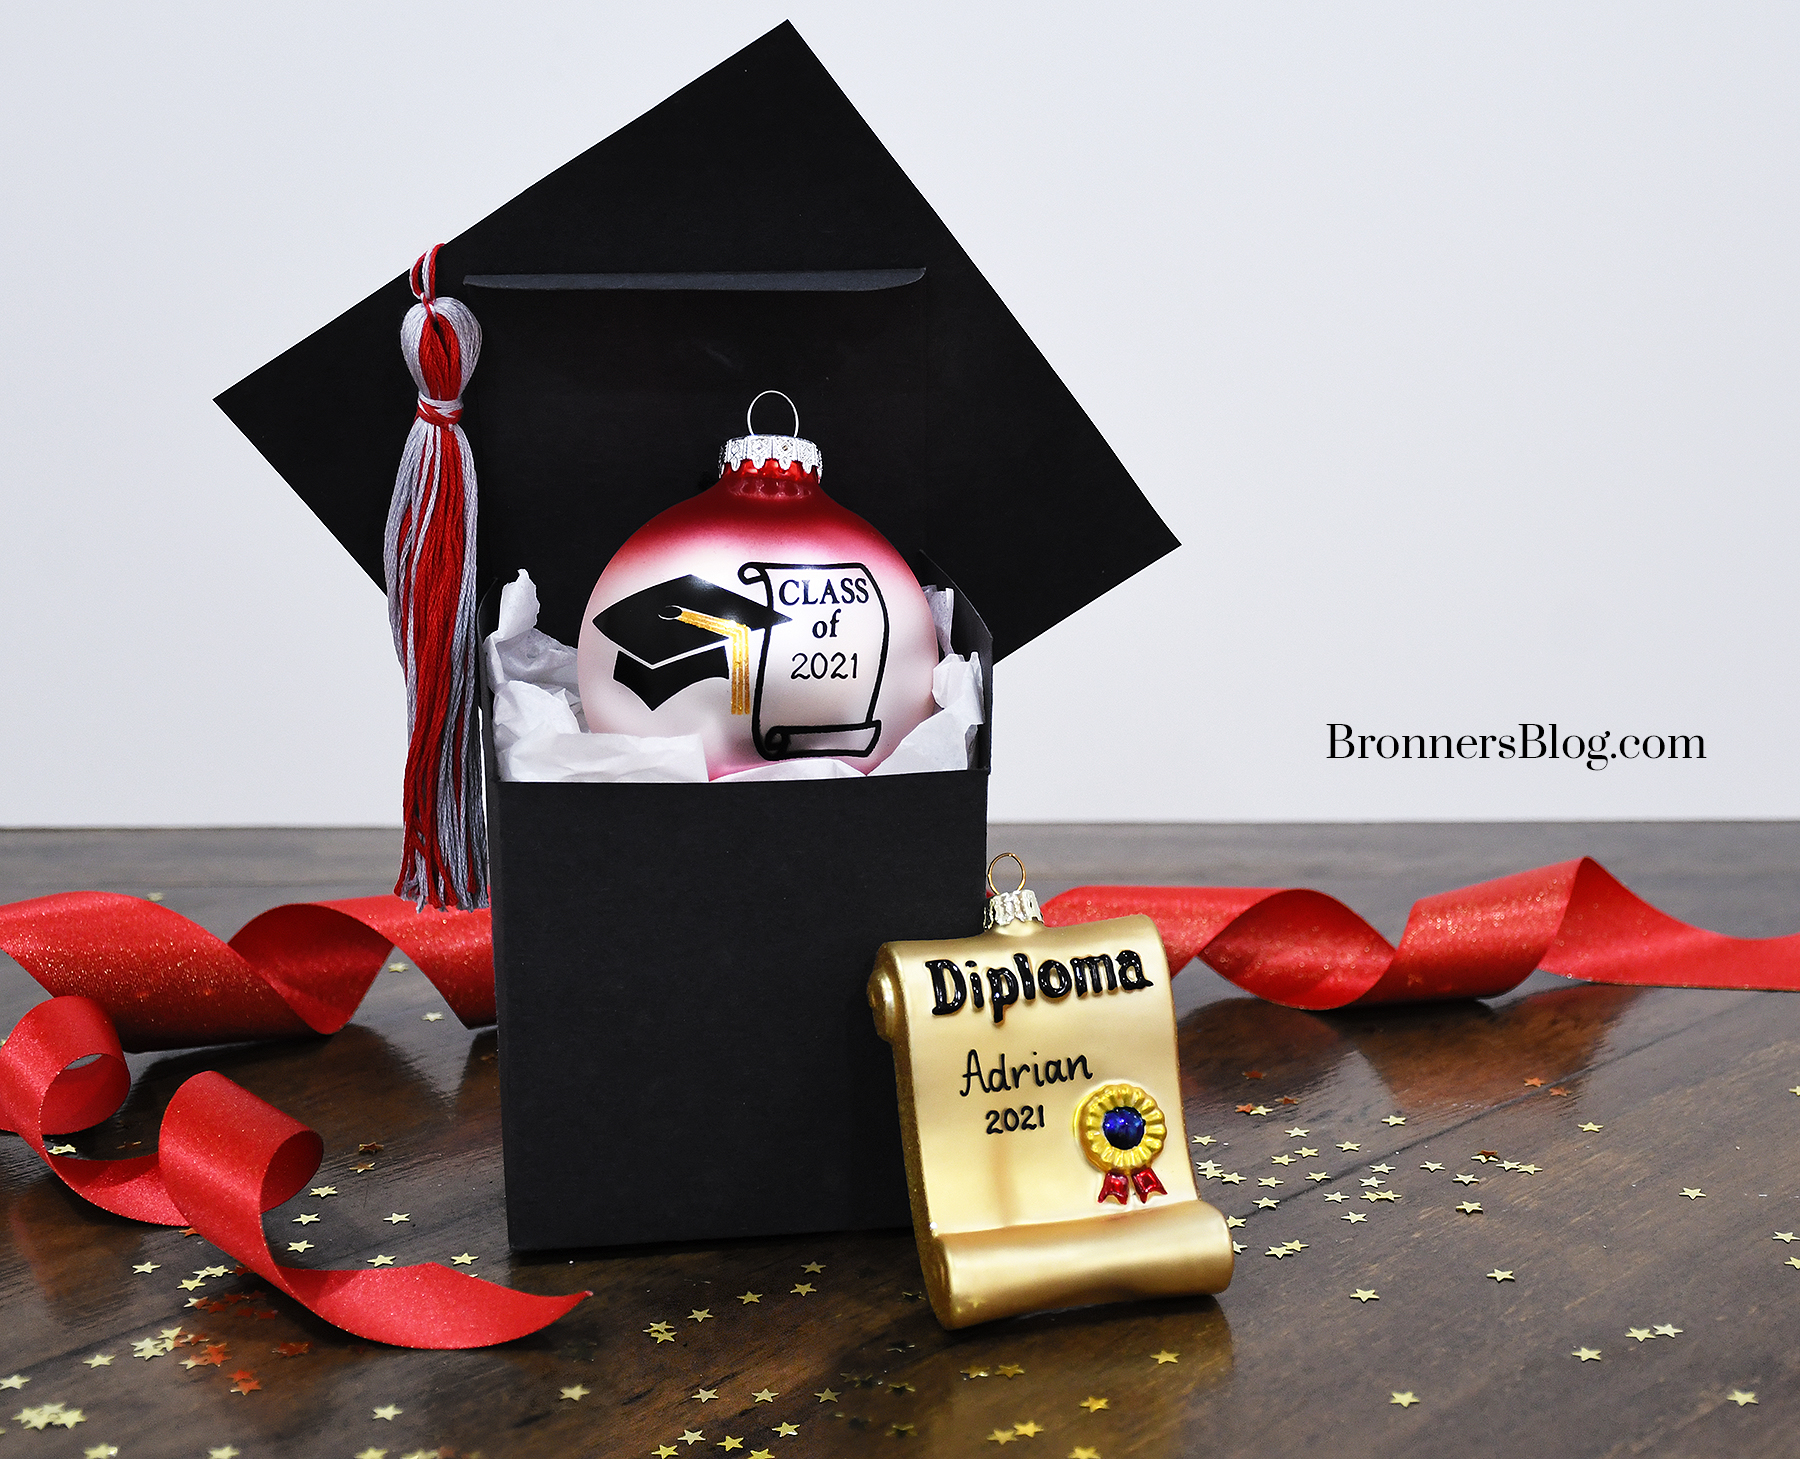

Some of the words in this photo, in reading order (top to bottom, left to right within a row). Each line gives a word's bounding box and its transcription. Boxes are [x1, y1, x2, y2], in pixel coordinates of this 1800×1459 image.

[779, 578, 869, 606] CLASS
[812, 608, 842, 639] of
[790, 652, 858, 680] 2021
[924, 950, 1154, 1024] Diploma
[959, 1048, 1093, 1097] Adrian
[985, 1104, 1045, 1135] 2021
